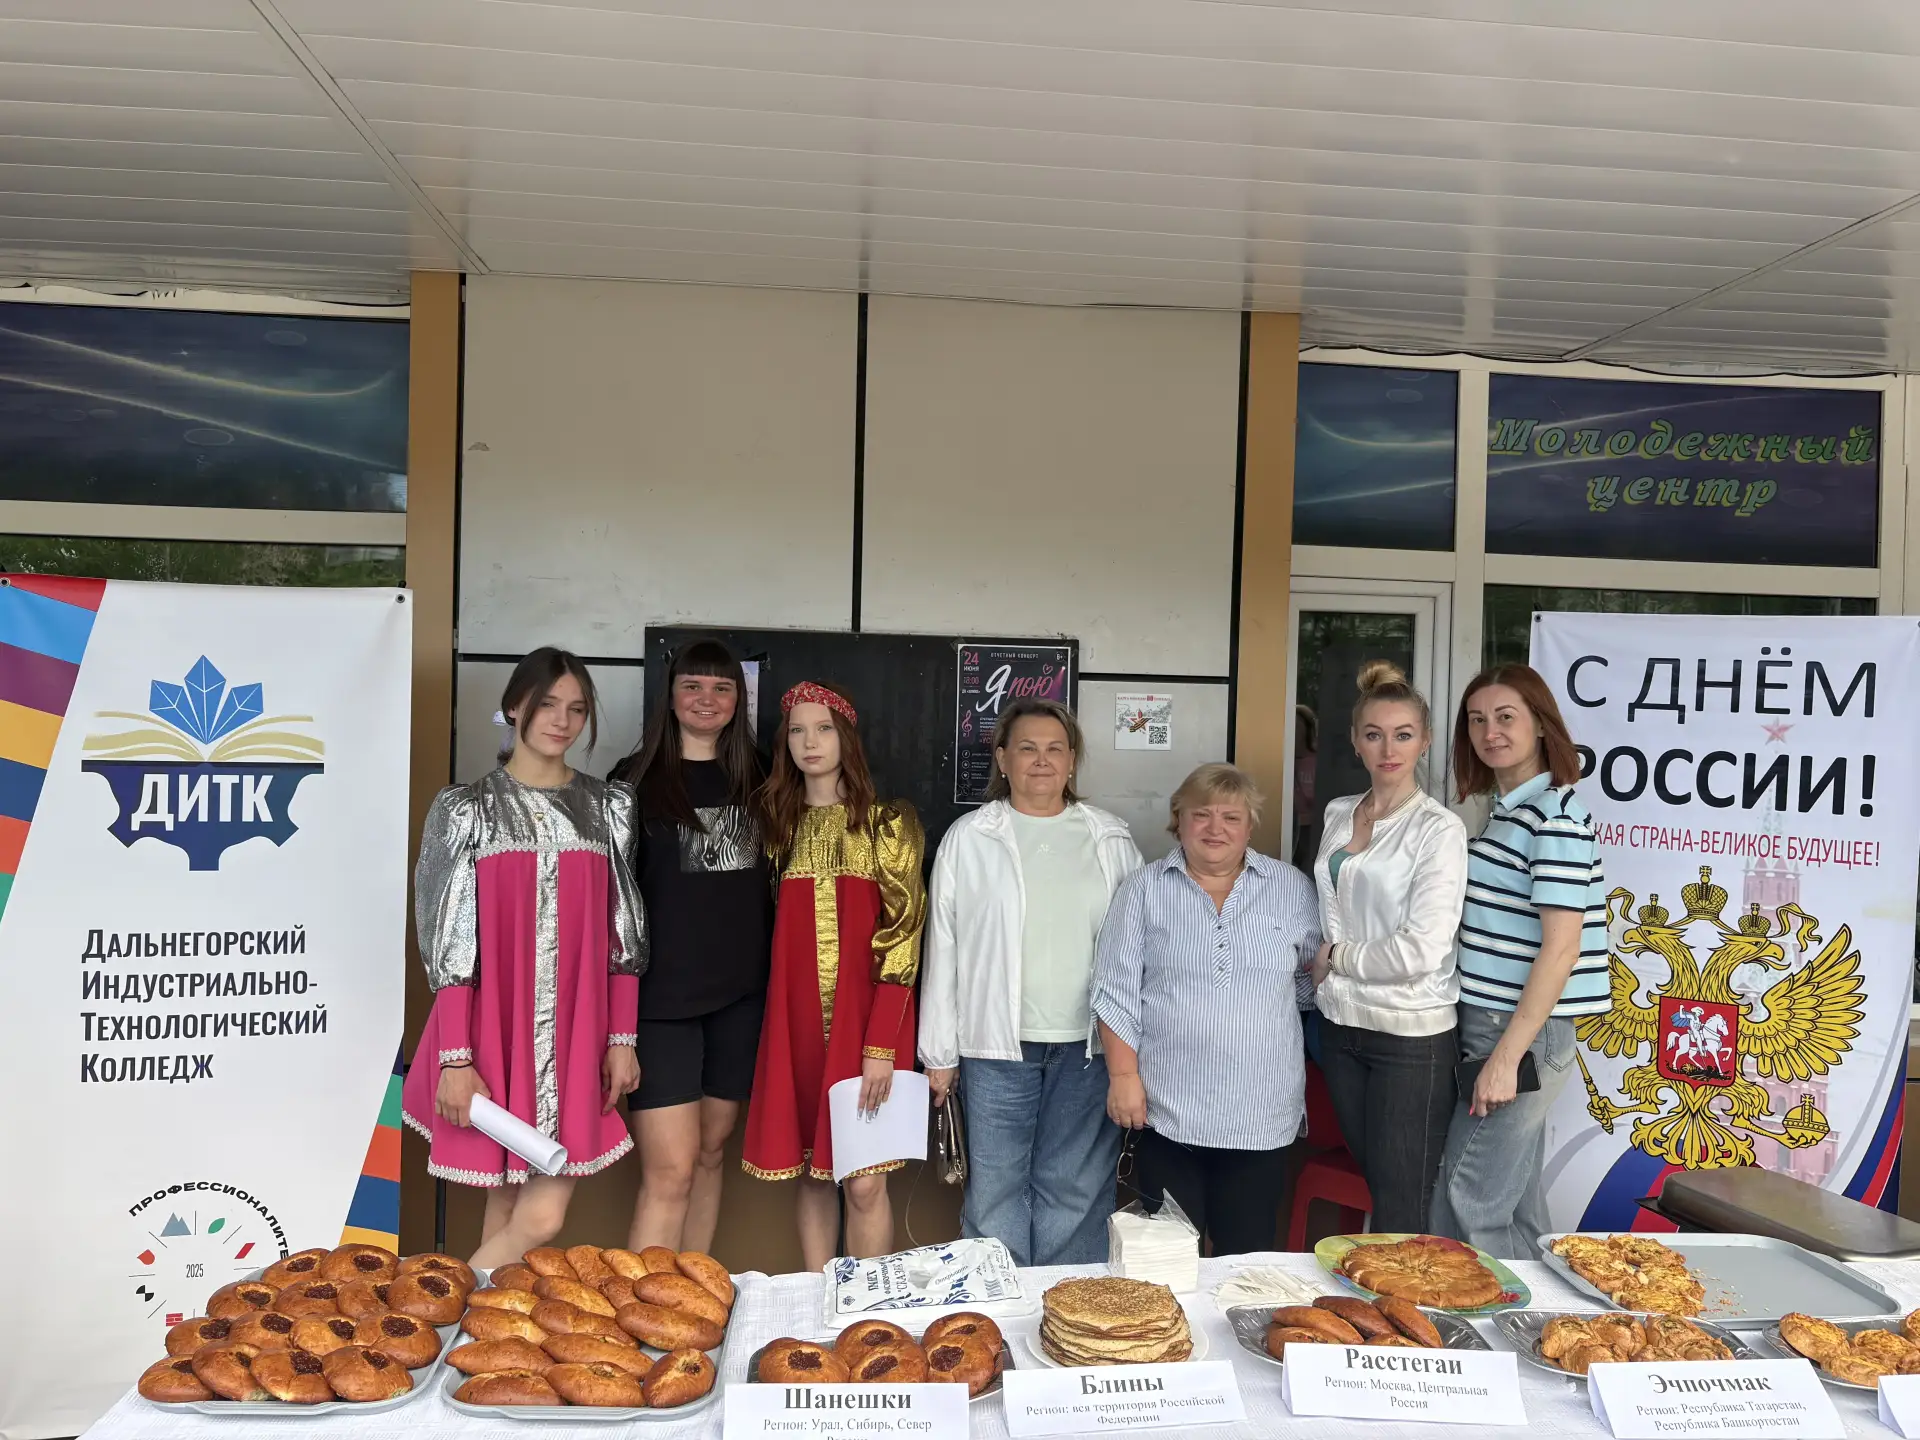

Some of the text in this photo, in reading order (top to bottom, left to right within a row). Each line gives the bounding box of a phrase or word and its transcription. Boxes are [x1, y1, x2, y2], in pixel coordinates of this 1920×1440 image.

[1487, 417, 1876, 466] Молодежный
[1587, 474, 1778, 517] центр
[964, 651, 979, 665] 24
[975, 664, 1012, 715] Я
[1566, 646, 1877, 725] С ДНЁМ
[130, 773, 274, 832] ДИТК
[1787, 836, 1880, 868] БУДУЩЕЕ!
[128, 1181, 290, 1260] ПРОФЕССИОНАЛИТЕ
[185, 1263, 204, 1279] 2025
[1344, 1347, 1463, 1375] Расстегаи
[1080, 1374, 1164, 1395] Блины
[1324, 1375, 1489, 1398] Регион: Москва, Центральная
[1647, 1374, 1772, 1394] Эчпочмак
[785, 1388, 911, 1409] Шанешки
[1025, 1395, 1226, 1418] Регион: вся территория Российской
[1390, 1396, 1428, 1409] Россия
[1636, 1400, 1807, 1417] Регион: Республика Татарстан,
[763, 1417, 932, 1433] Регион: Урал, Сибирь, Север
[1097, 1413, 1161, 1427] Федерации
[1655, 1416, 1800, 1432] Республика Башкортостан
